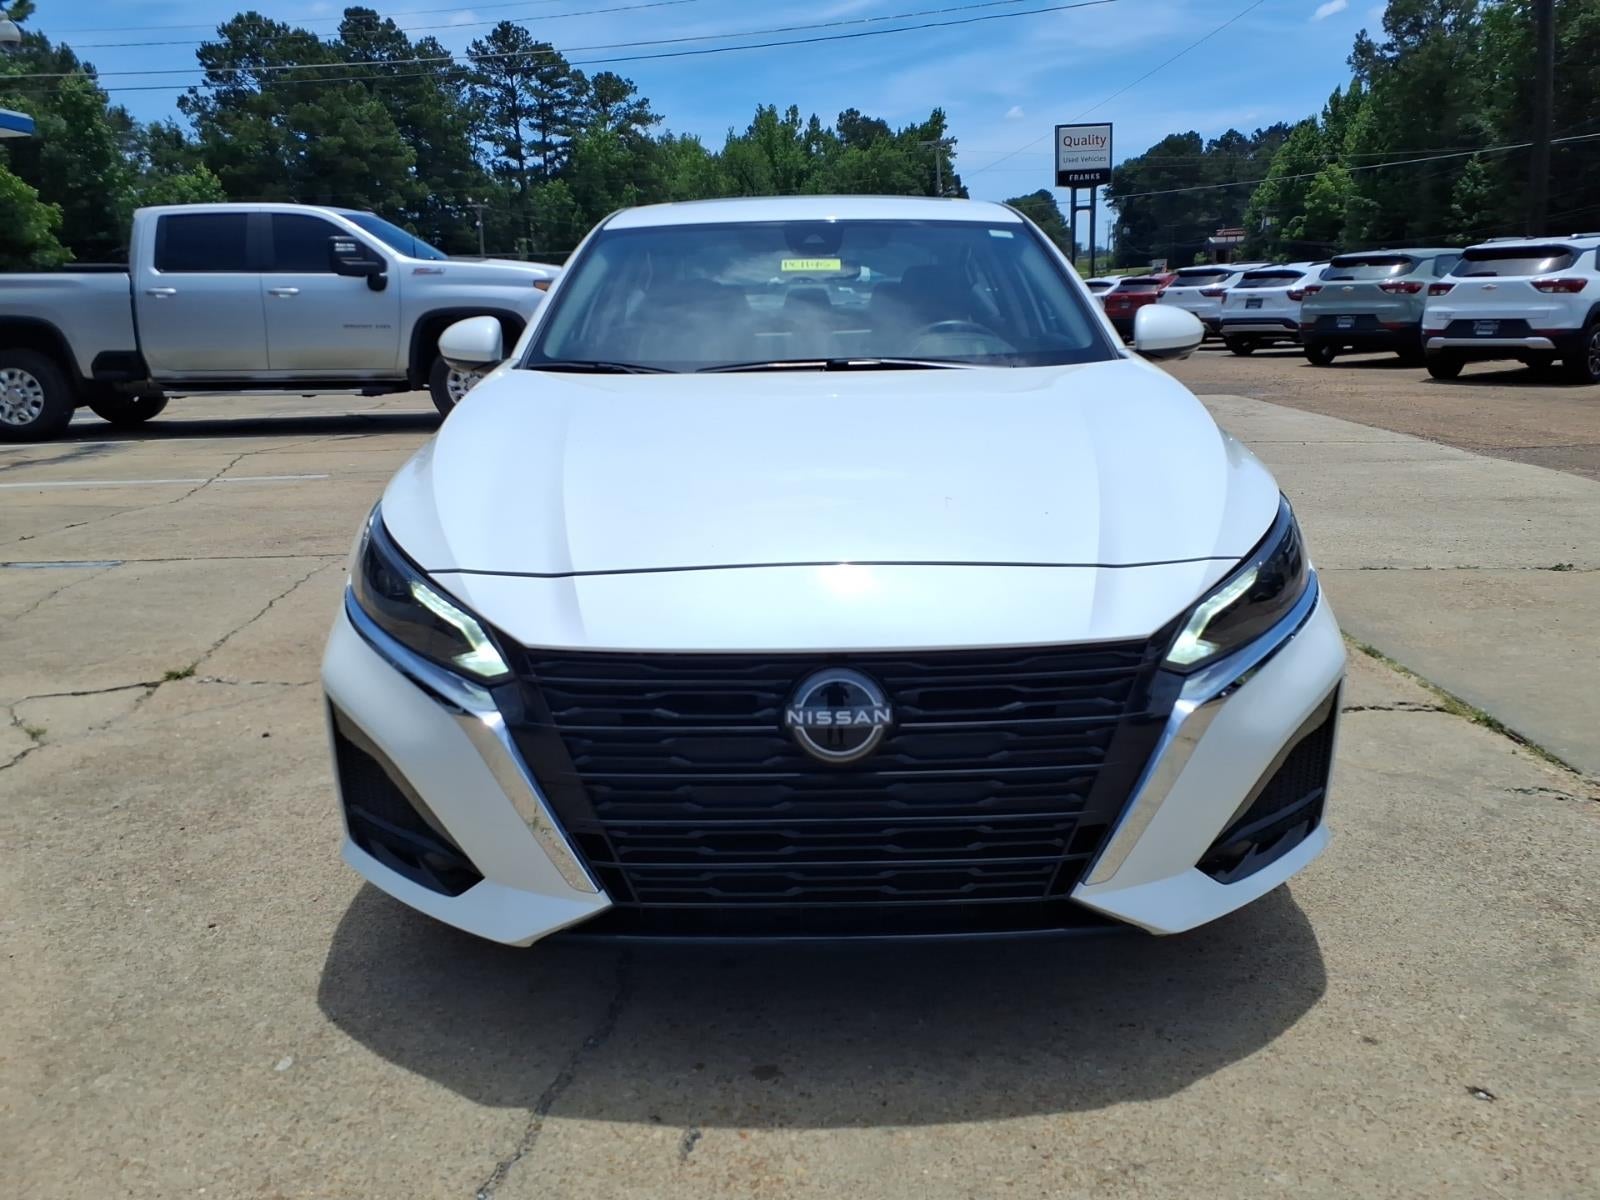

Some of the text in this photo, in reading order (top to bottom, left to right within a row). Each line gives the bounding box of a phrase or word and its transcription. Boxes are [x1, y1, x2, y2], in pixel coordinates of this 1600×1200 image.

[1063, 134, 1107, 148] Quality
[1063, 155, 1107, 164] Used Vehicles
[1069, 172, 1101, 181] FRANKS
[786, 708, 891, 725] NISSAN
